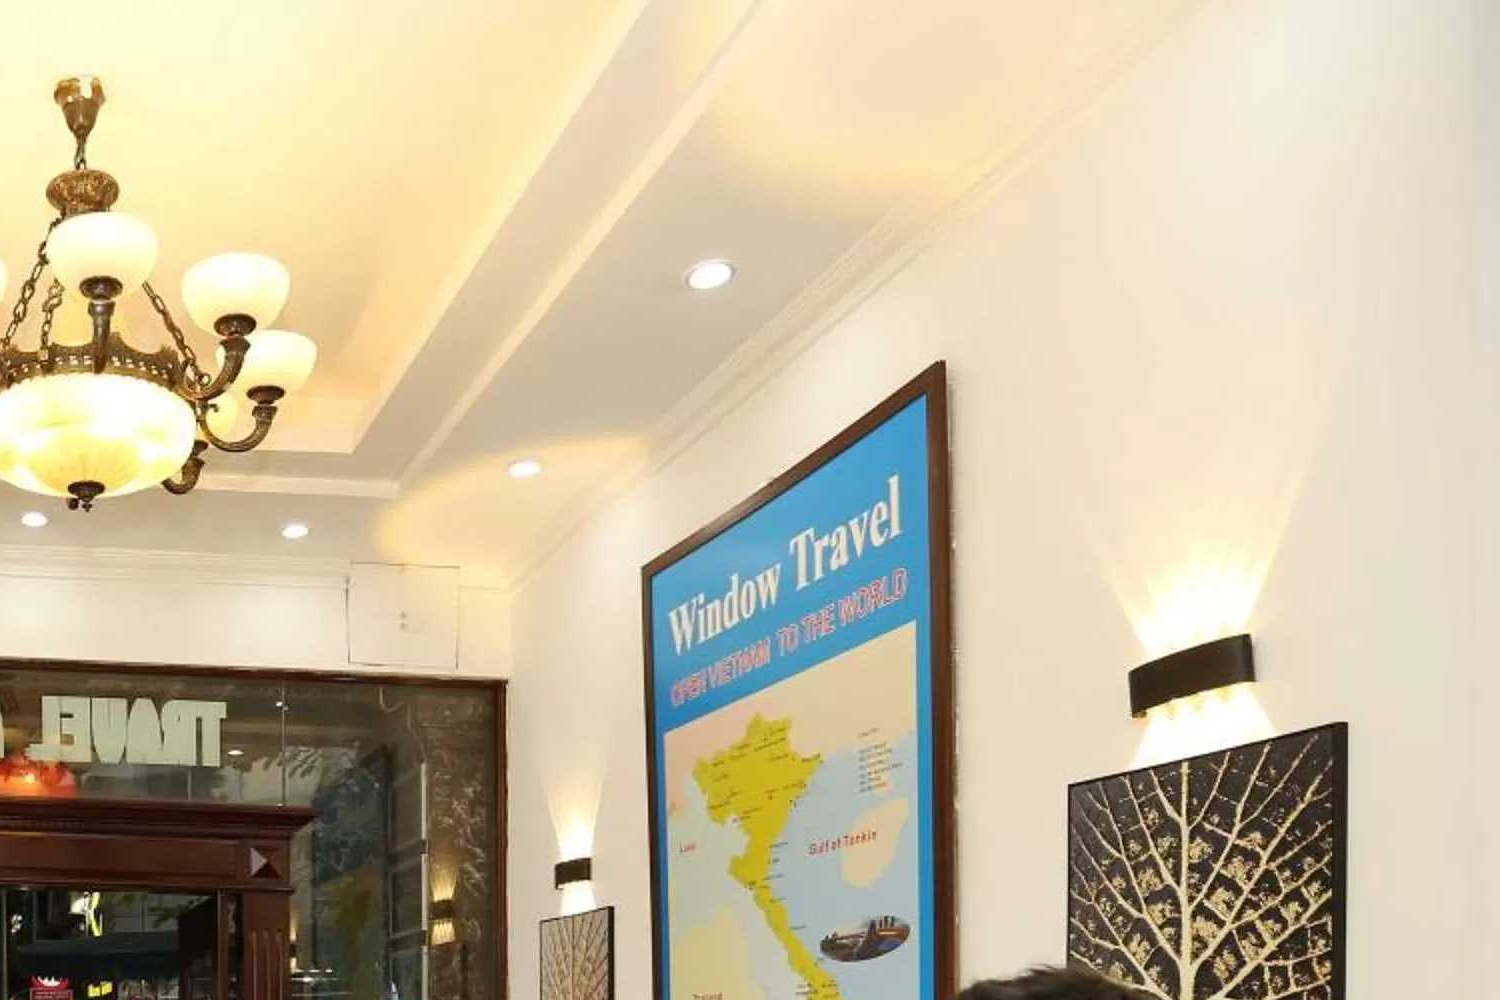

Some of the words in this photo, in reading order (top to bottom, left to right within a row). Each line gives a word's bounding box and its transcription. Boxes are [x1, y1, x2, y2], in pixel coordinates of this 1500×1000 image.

[668, 563, 781, 656] Window
[789, 473, 904, 592] Travel
[671, 669, 707, 708] OPEN
[708, 636, 771, 690] VIETNAM
[776, 623, 800, 657] TO
[803, 603, 836, 645] THE
[839, 567, 909, 627] WORLD
